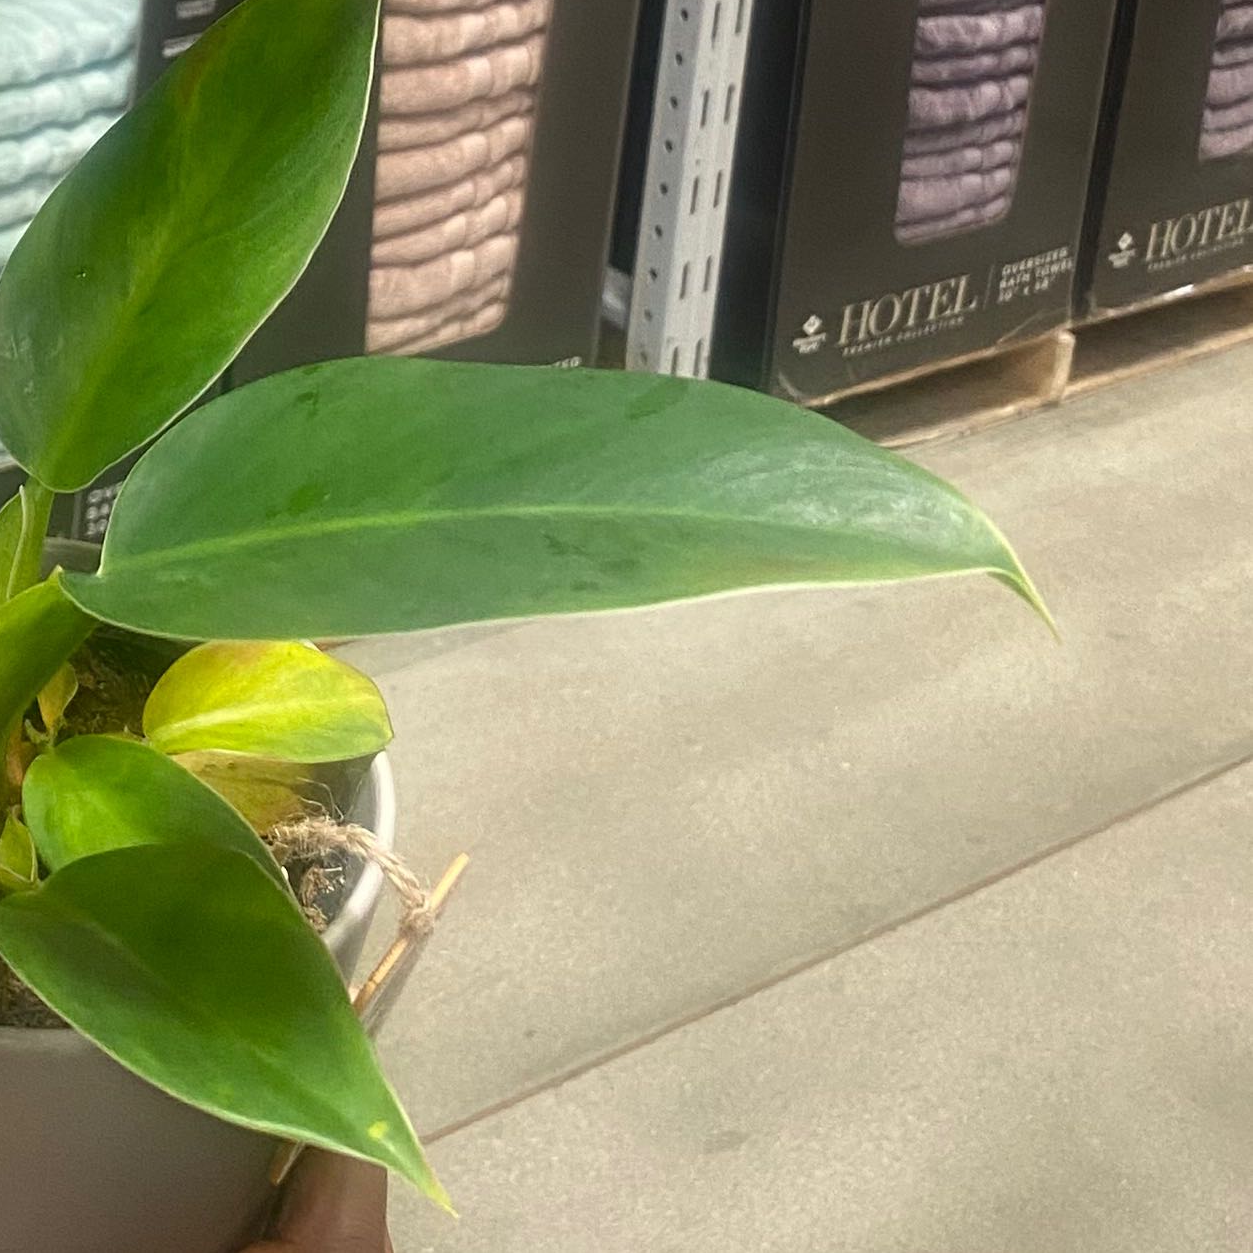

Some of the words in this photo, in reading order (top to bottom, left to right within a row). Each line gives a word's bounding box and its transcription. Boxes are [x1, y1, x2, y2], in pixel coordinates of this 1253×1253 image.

[1145, 198, 1253, 261] HOTEL
[999, 272, 1031, 289] BATH
[1035, 258, 1073, 278] TOWEL
[1001, 247, 1069, 276] OVERSIZED
[838, 273, 978, 347] HOTEL
